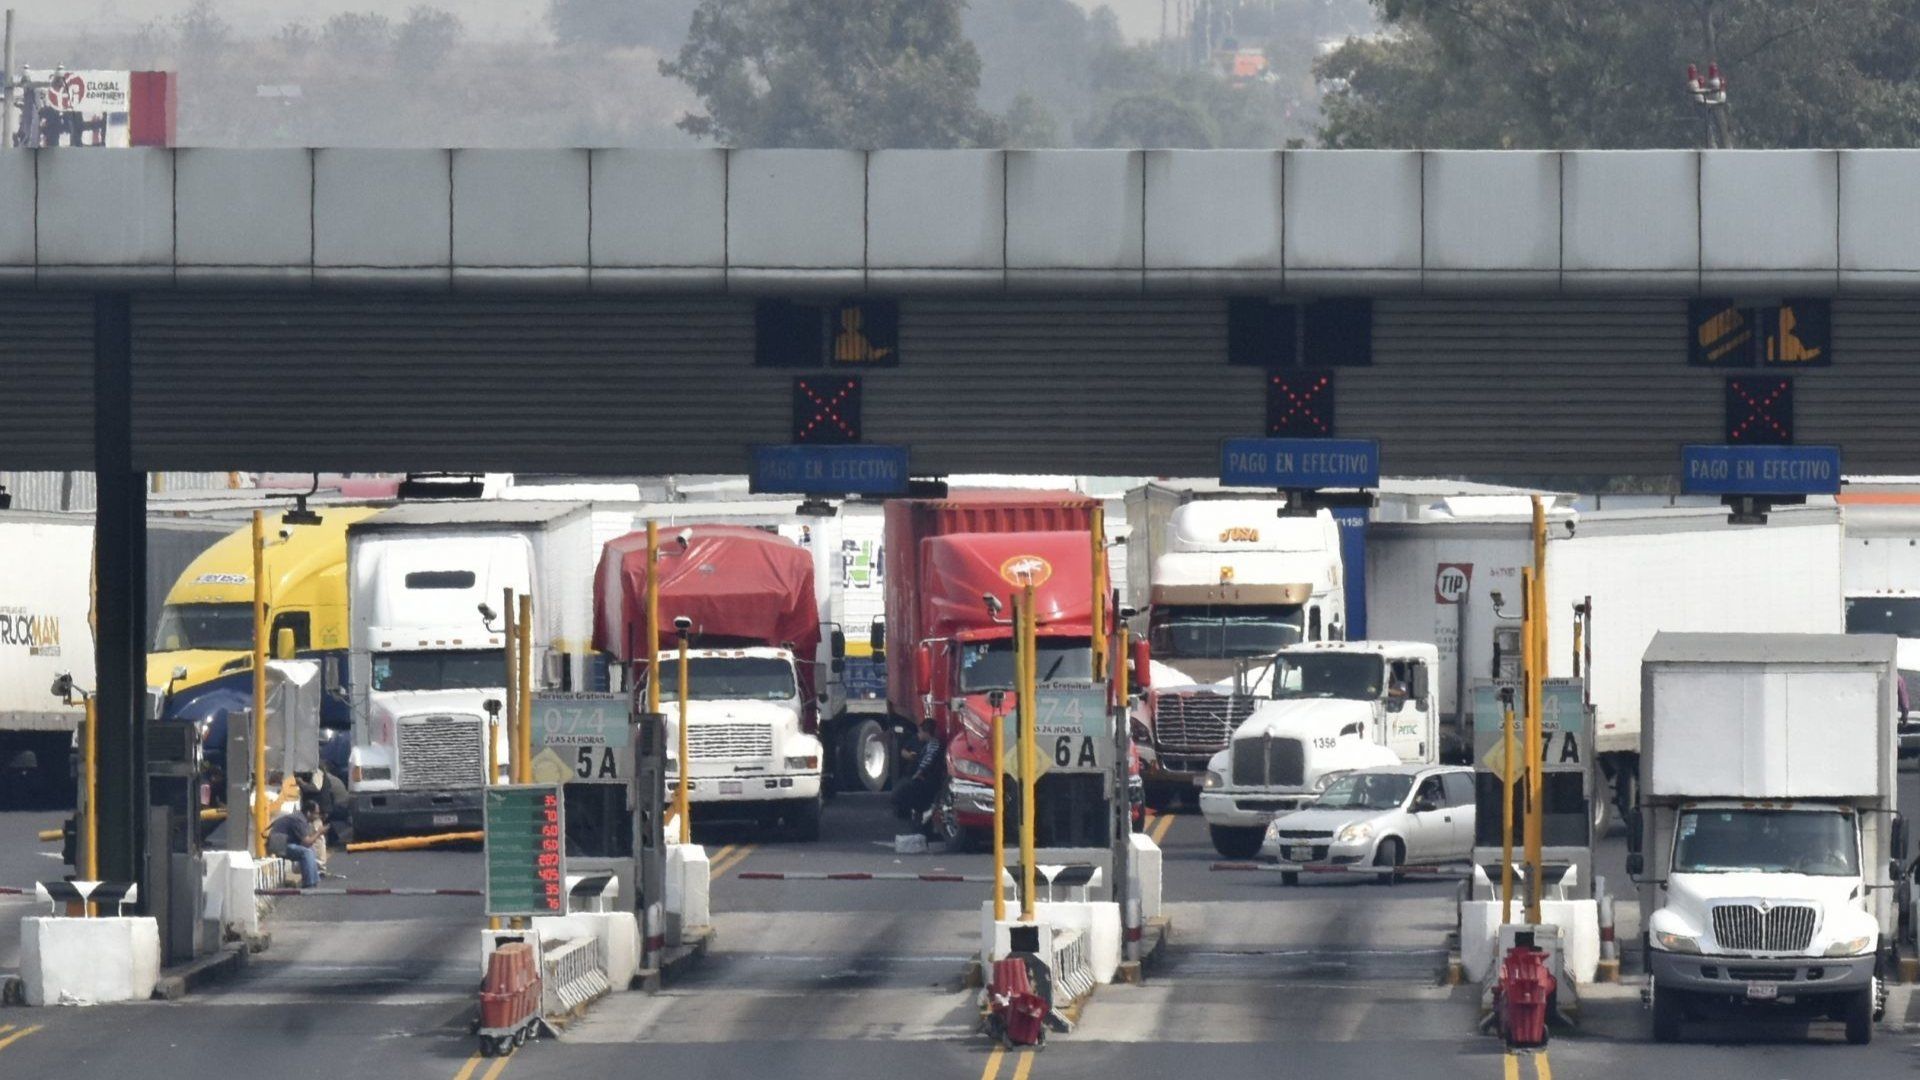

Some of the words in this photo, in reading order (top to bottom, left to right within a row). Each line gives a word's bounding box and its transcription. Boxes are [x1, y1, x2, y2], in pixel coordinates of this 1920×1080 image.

[86, 82, 119, 91] GLOBAL
[805, 460, 823, 480] EN
[831, 460, 898, 480] EFECTIVO
[1230, 453, 1267, 473] PAGO
[1276, 453, 1293, 474] EN
[1302, 453, 1368, 474] EFECTIVO
[1691, 460, 1729, 480] PAGO
[1737, 460, 1755, 480] EN
[1763, 460, 1831, 480] EFECTIVO
[1442, 575, 1464, 594] TIP
[0, 614, 60, 646] RUCKMAN
[543, 708, 606, 735] 074
[1039, 698, 1083, 724] 74
[1055, 735, 1071, 768] 6
[1078, 735, 1097, 768] A
[1541, 731, 1553, 762] 7
[1560, 731, 1580, 764] A
[577, 746, 592, 779] 5
[599, 746, 617, 779] A
